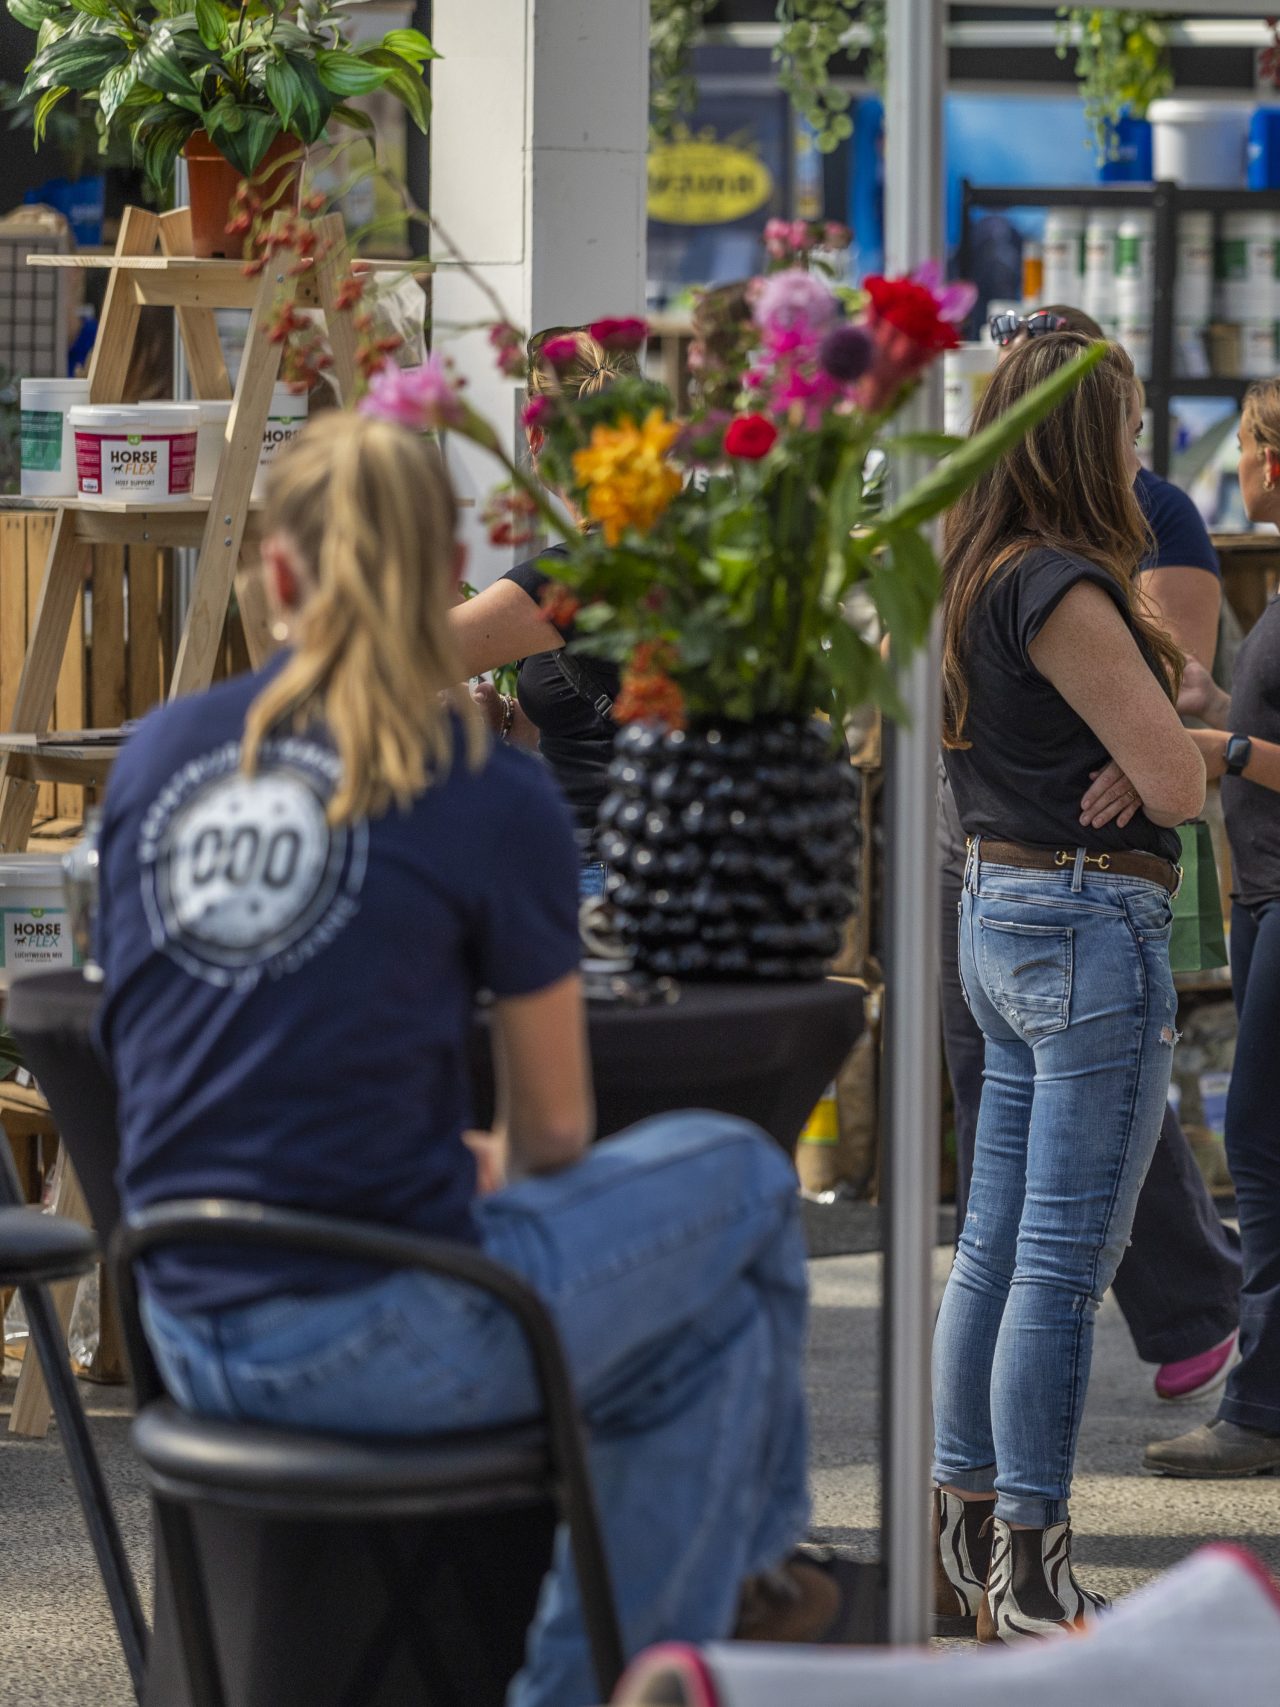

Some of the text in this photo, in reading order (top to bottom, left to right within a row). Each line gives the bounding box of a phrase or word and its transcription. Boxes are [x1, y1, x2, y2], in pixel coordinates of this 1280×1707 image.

[110, 450, 158, 463] HORSE
[125, 463, 156, 475] FLEX
[14, 923, 61, 936] HORSE
[28, 936, 59, 947] FLEX
